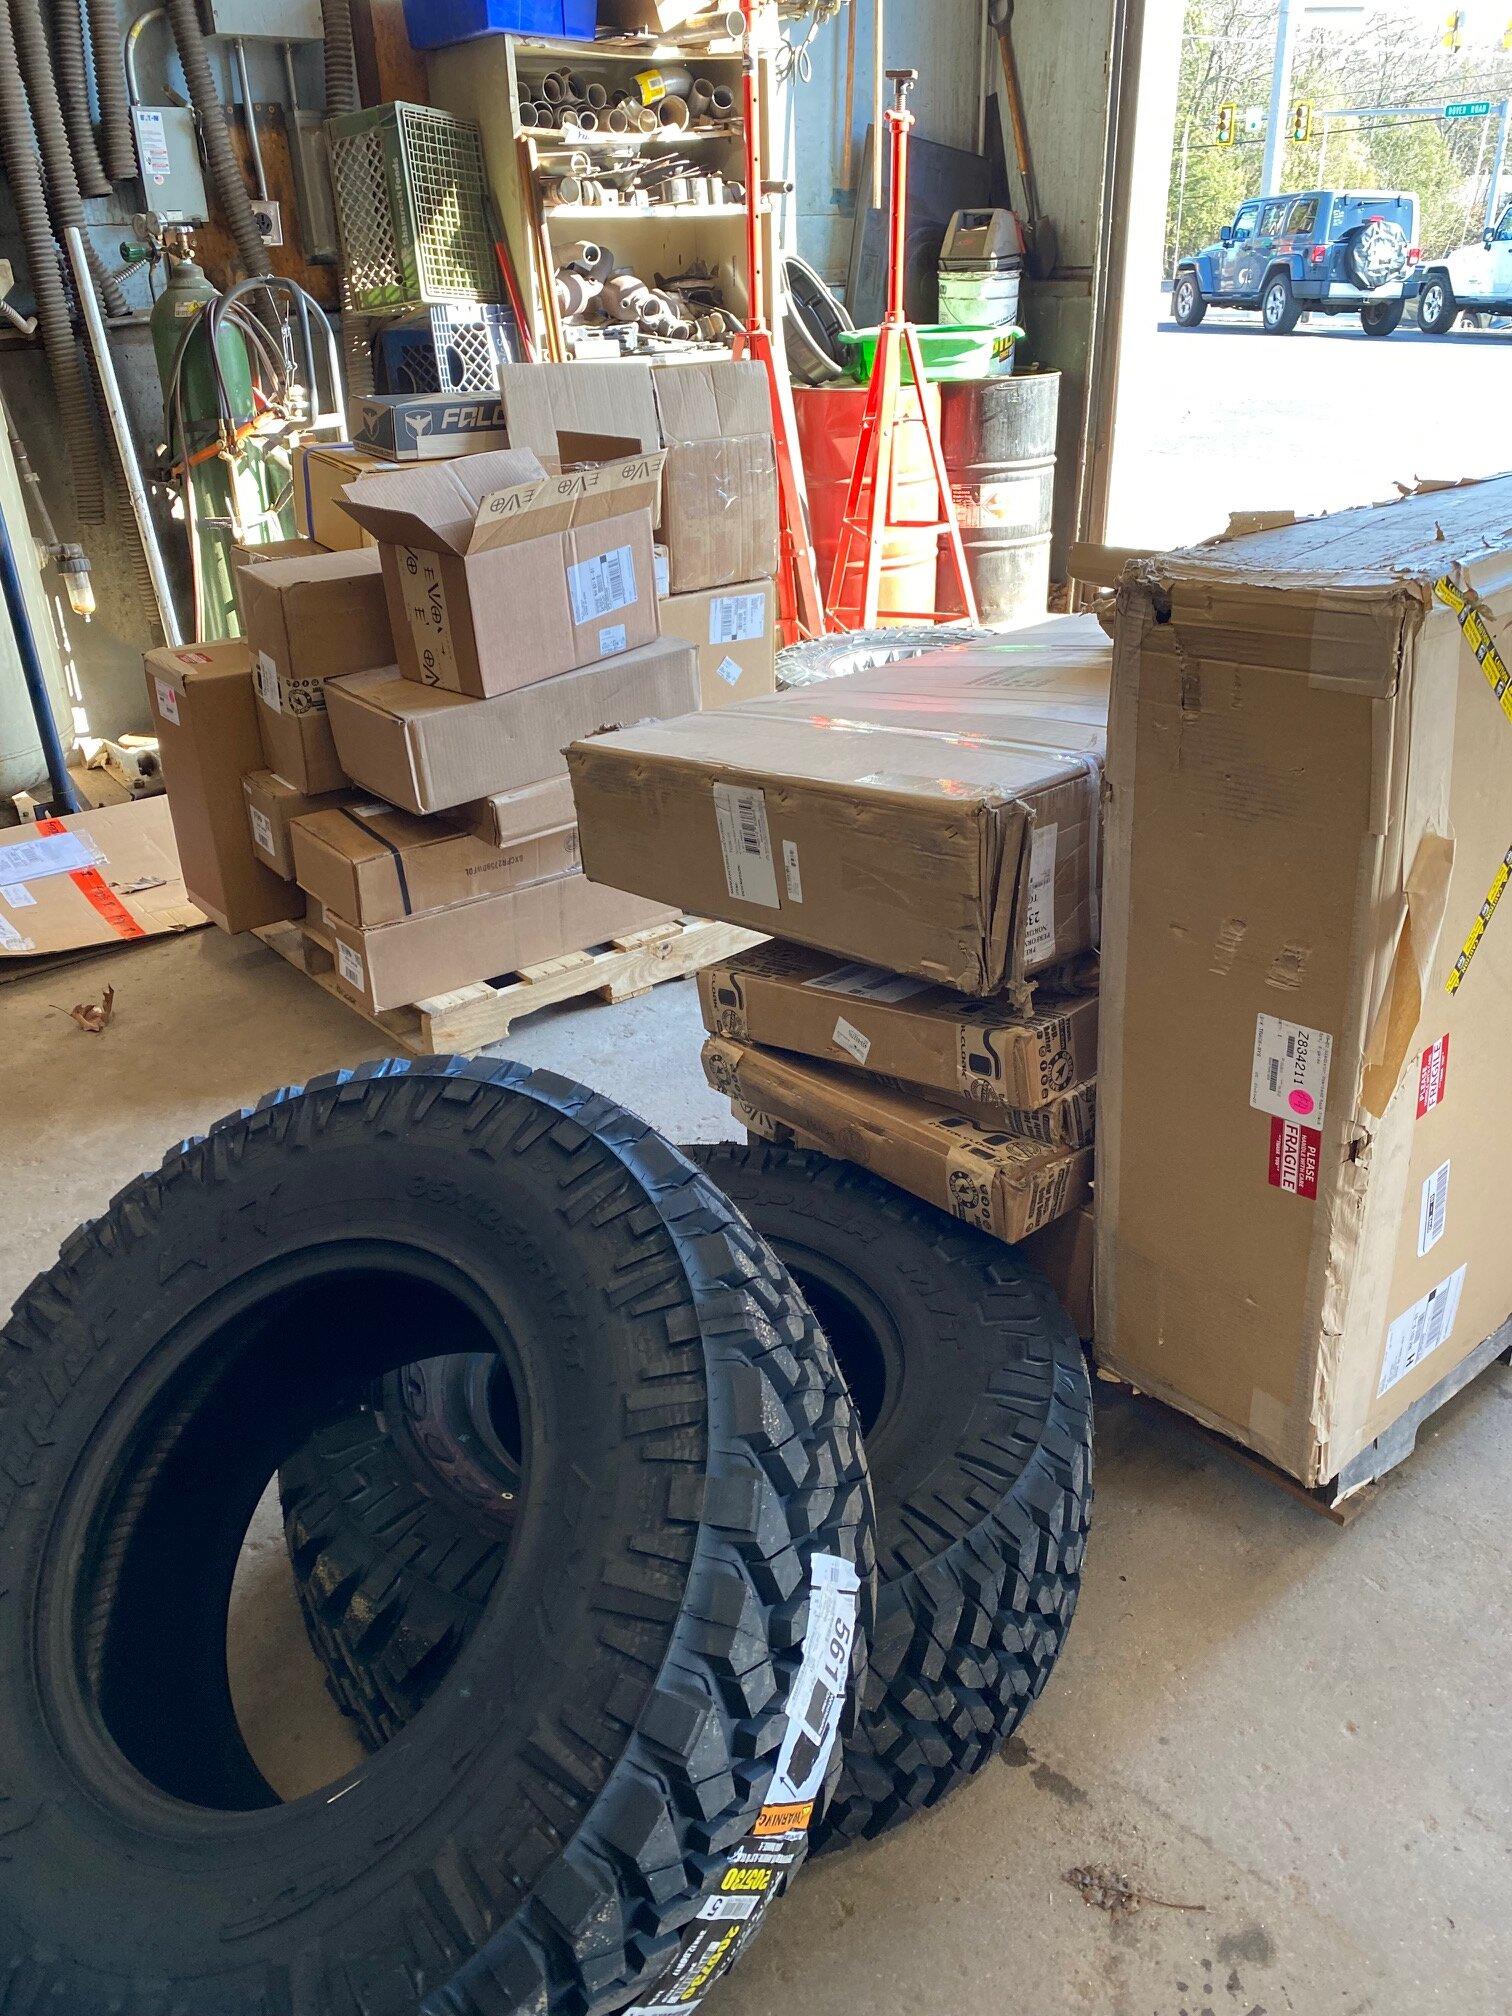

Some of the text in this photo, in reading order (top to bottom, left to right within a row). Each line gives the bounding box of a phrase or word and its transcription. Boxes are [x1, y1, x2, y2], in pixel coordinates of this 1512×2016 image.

[1471, 104, 1487, 114] ROAD
[1294, 1031, 1309, 1085] Z834211
[1429, 1042, 1441, 1106] FRAGILE
[1283, 1125, 1298, 1189] FRAGILE
[1306, 1146, 1316, 1182] PLEASE
[824, 1618, 849, 1683] 561
[759, 1812, 801, 1826] WARNING
[707, 1898, 723, 1917] 5
